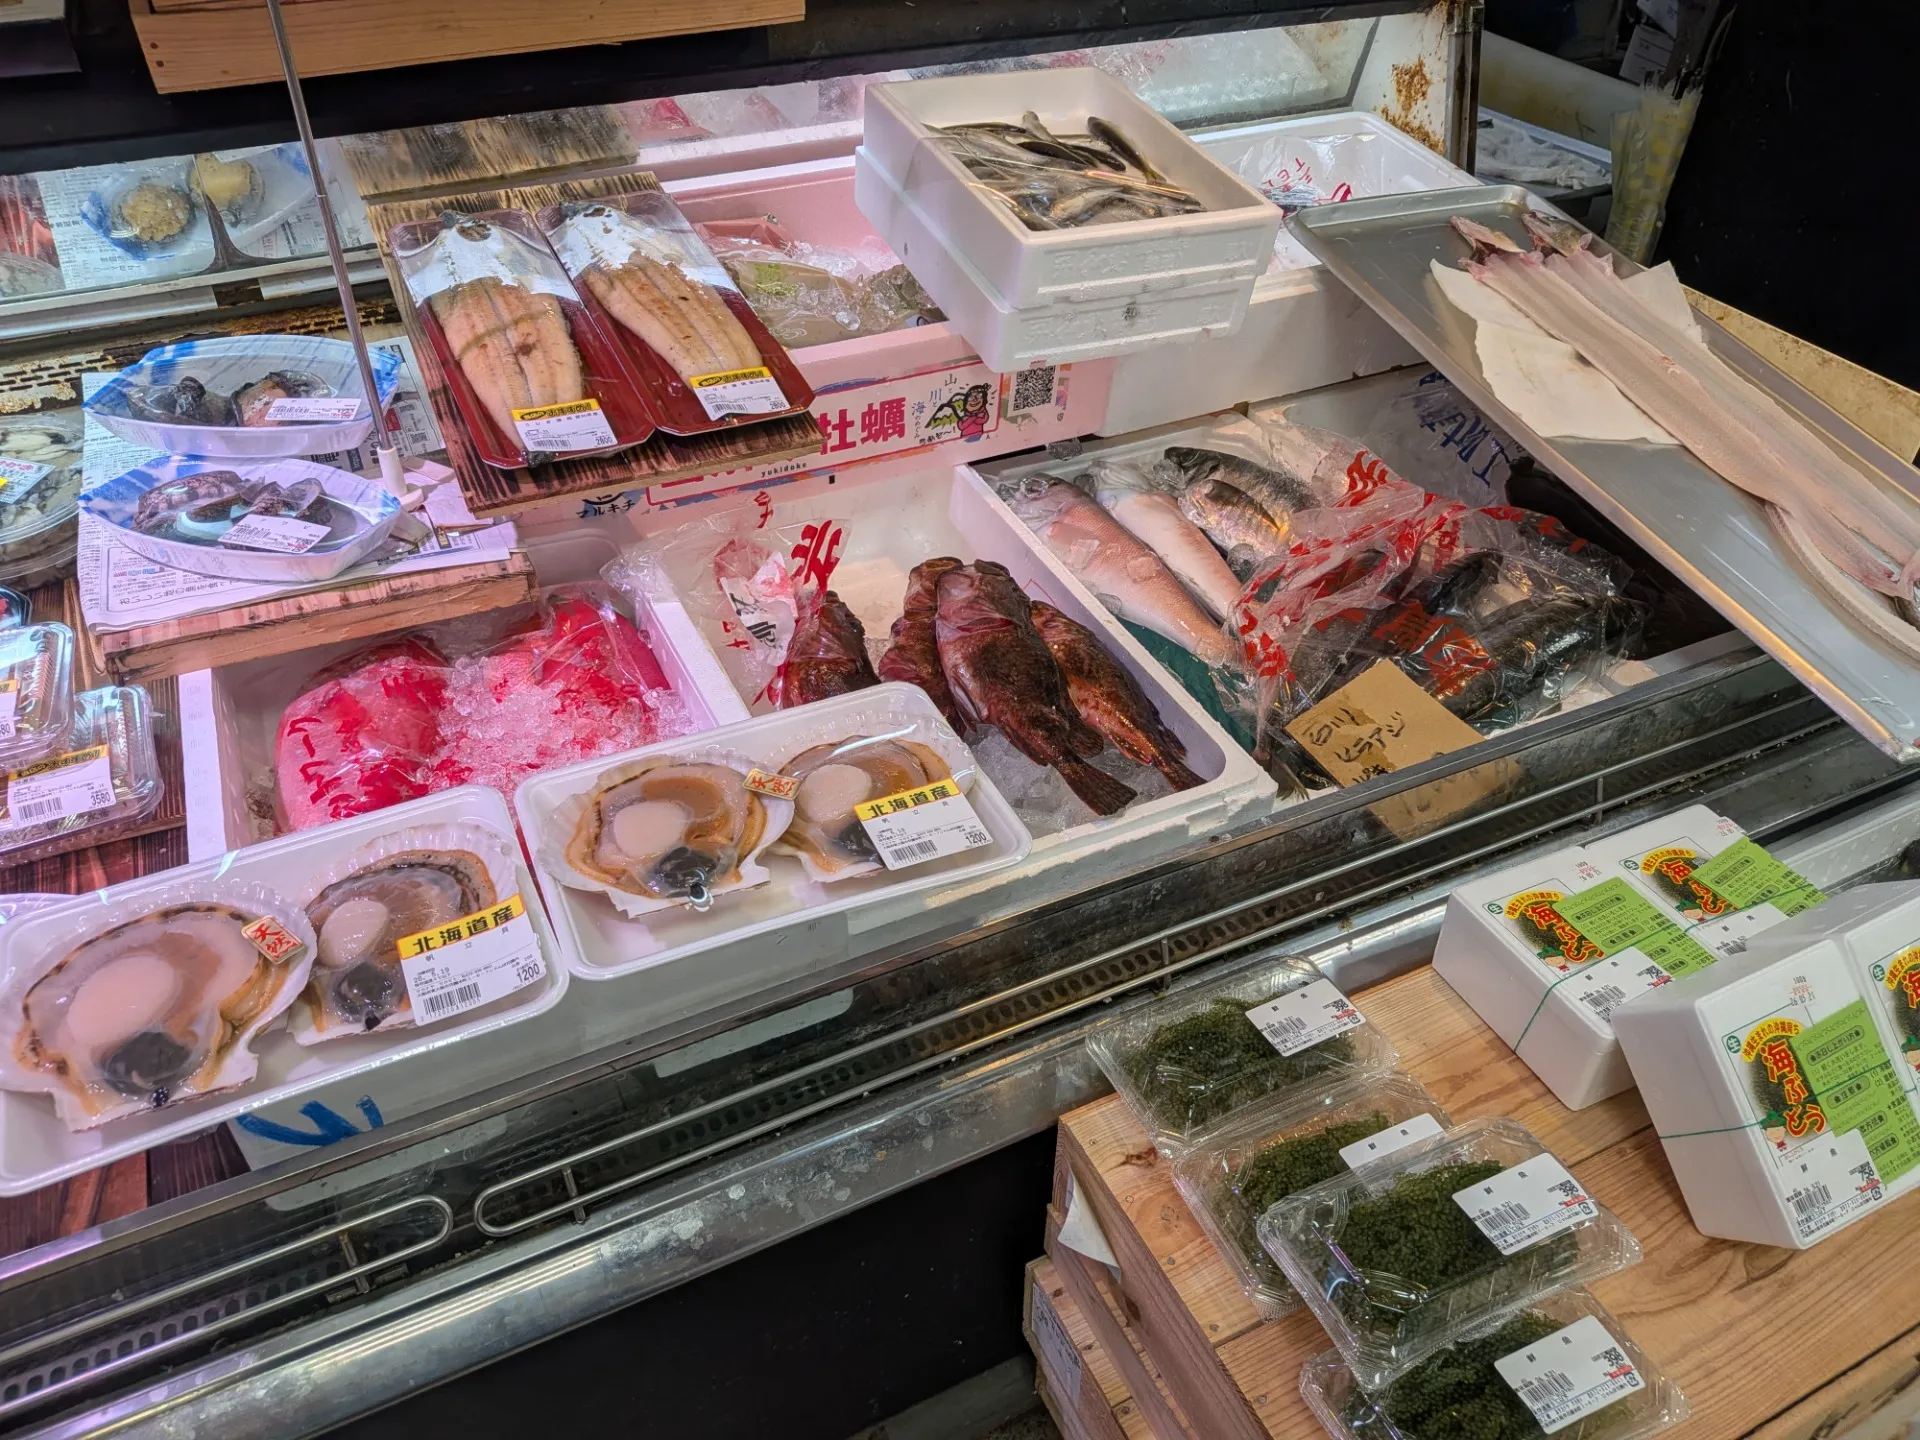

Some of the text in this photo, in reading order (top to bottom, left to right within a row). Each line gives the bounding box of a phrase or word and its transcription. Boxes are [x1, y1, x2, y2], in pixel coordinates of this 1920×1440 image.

[761, 462, 807, 478] yukidoke
[91, 792, 112, 806] 3580
[867, 784, 951, 819] 北海道産
[964, 832, 988, 847] 1200
[412, 904, 518, 956] 北海道産
[252, 919, 300, 961] 天然
[516, 962, 541, 984] 1200
[1335, 1001, 1349, 1013] 398
[1728, 1036, 1740, 1052] 生
[1742, 1019, 1800, 1060] 沖縄生まれの沖縄育ち
[1759, 1038, 1827, 1138] 海ぶどう
[1859, 1165, 1875, 1181] 758
[1559, 1180, 1579, 1197] 398
[1603, 1351, 1625, 1367] 398
